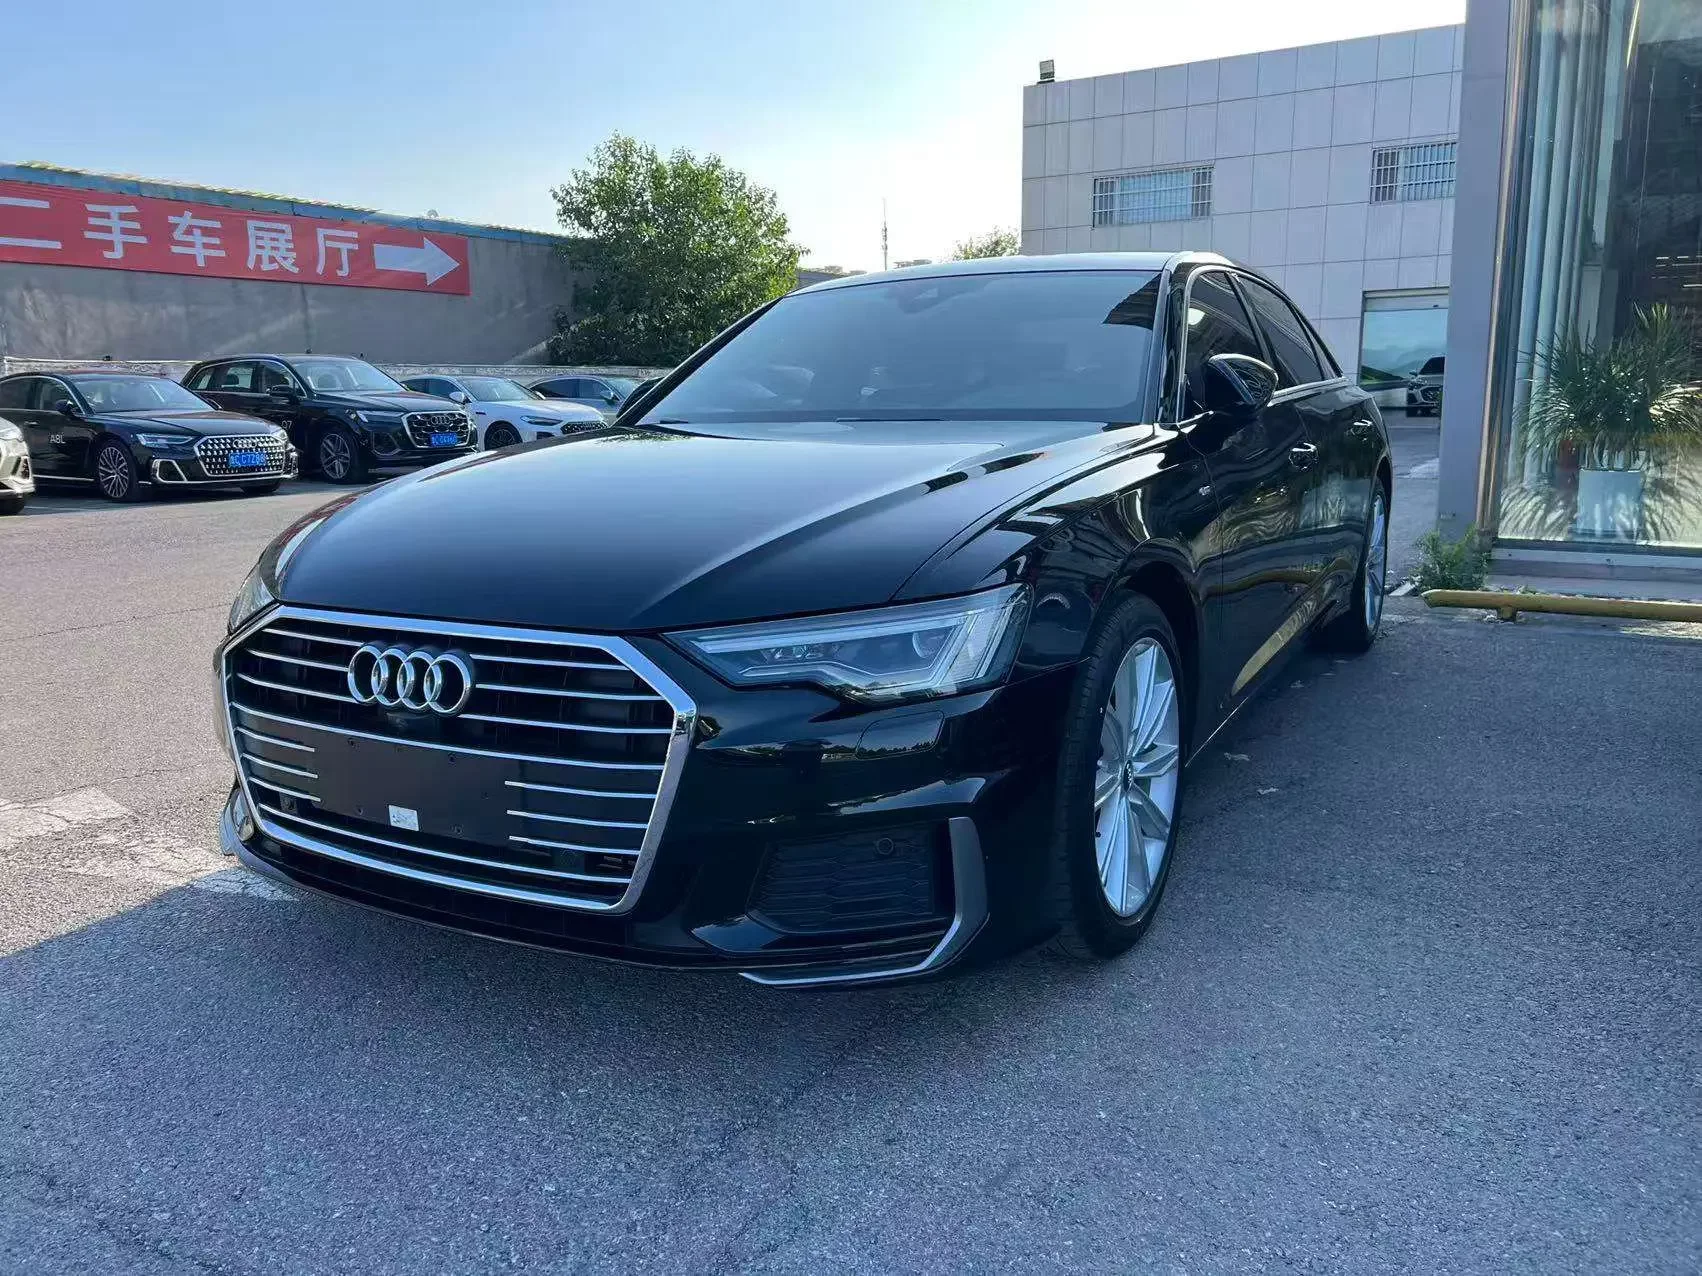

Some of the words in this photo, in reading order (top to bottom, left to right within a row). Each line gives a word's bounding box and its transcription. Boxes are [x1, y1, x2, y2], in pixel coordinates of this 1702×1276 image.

[0, 196, 360, 278] 二手车展厅
[50, 433, 66, 444] A8L
